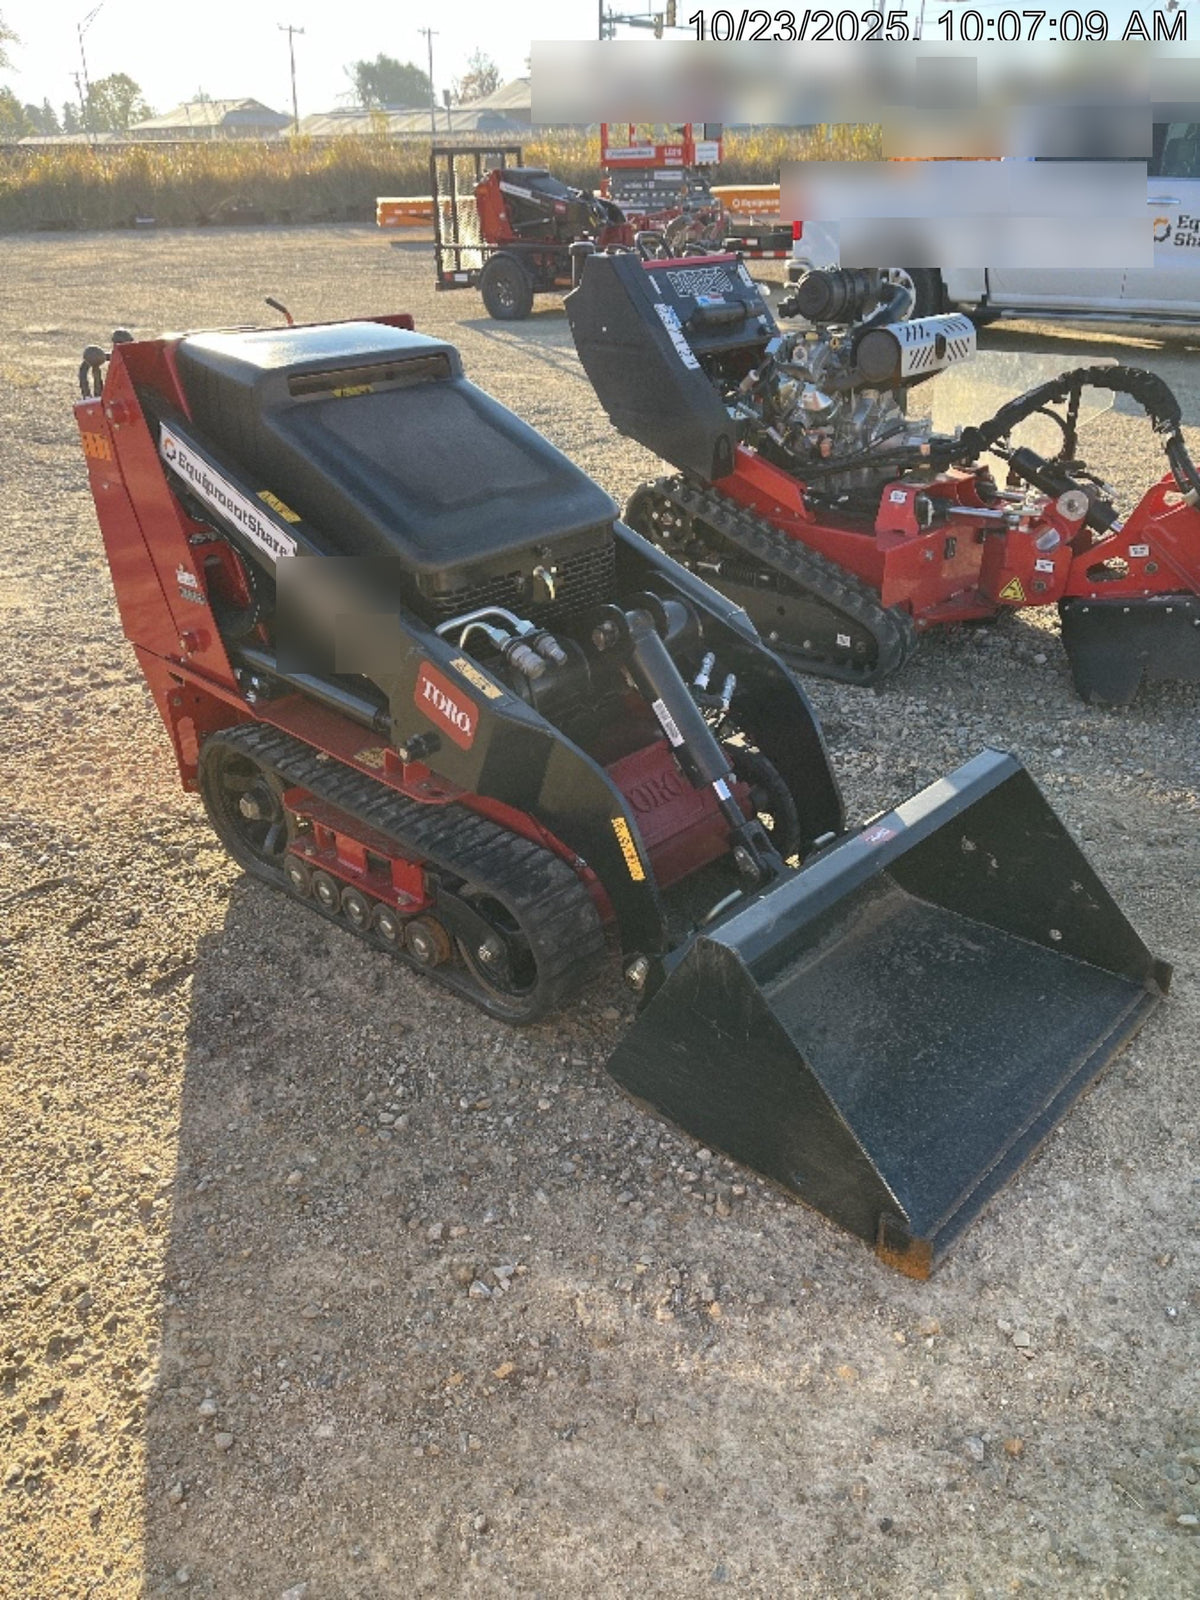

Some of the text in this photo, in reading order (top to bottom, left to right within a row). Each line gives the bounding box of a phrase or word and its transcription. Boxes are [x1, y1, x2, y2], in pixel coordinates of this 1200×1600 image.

[178, 451, 289, 557] EquipmentShare
[422, 677, 472, 734] TORO
[628, 769, 685, 814] ORO
